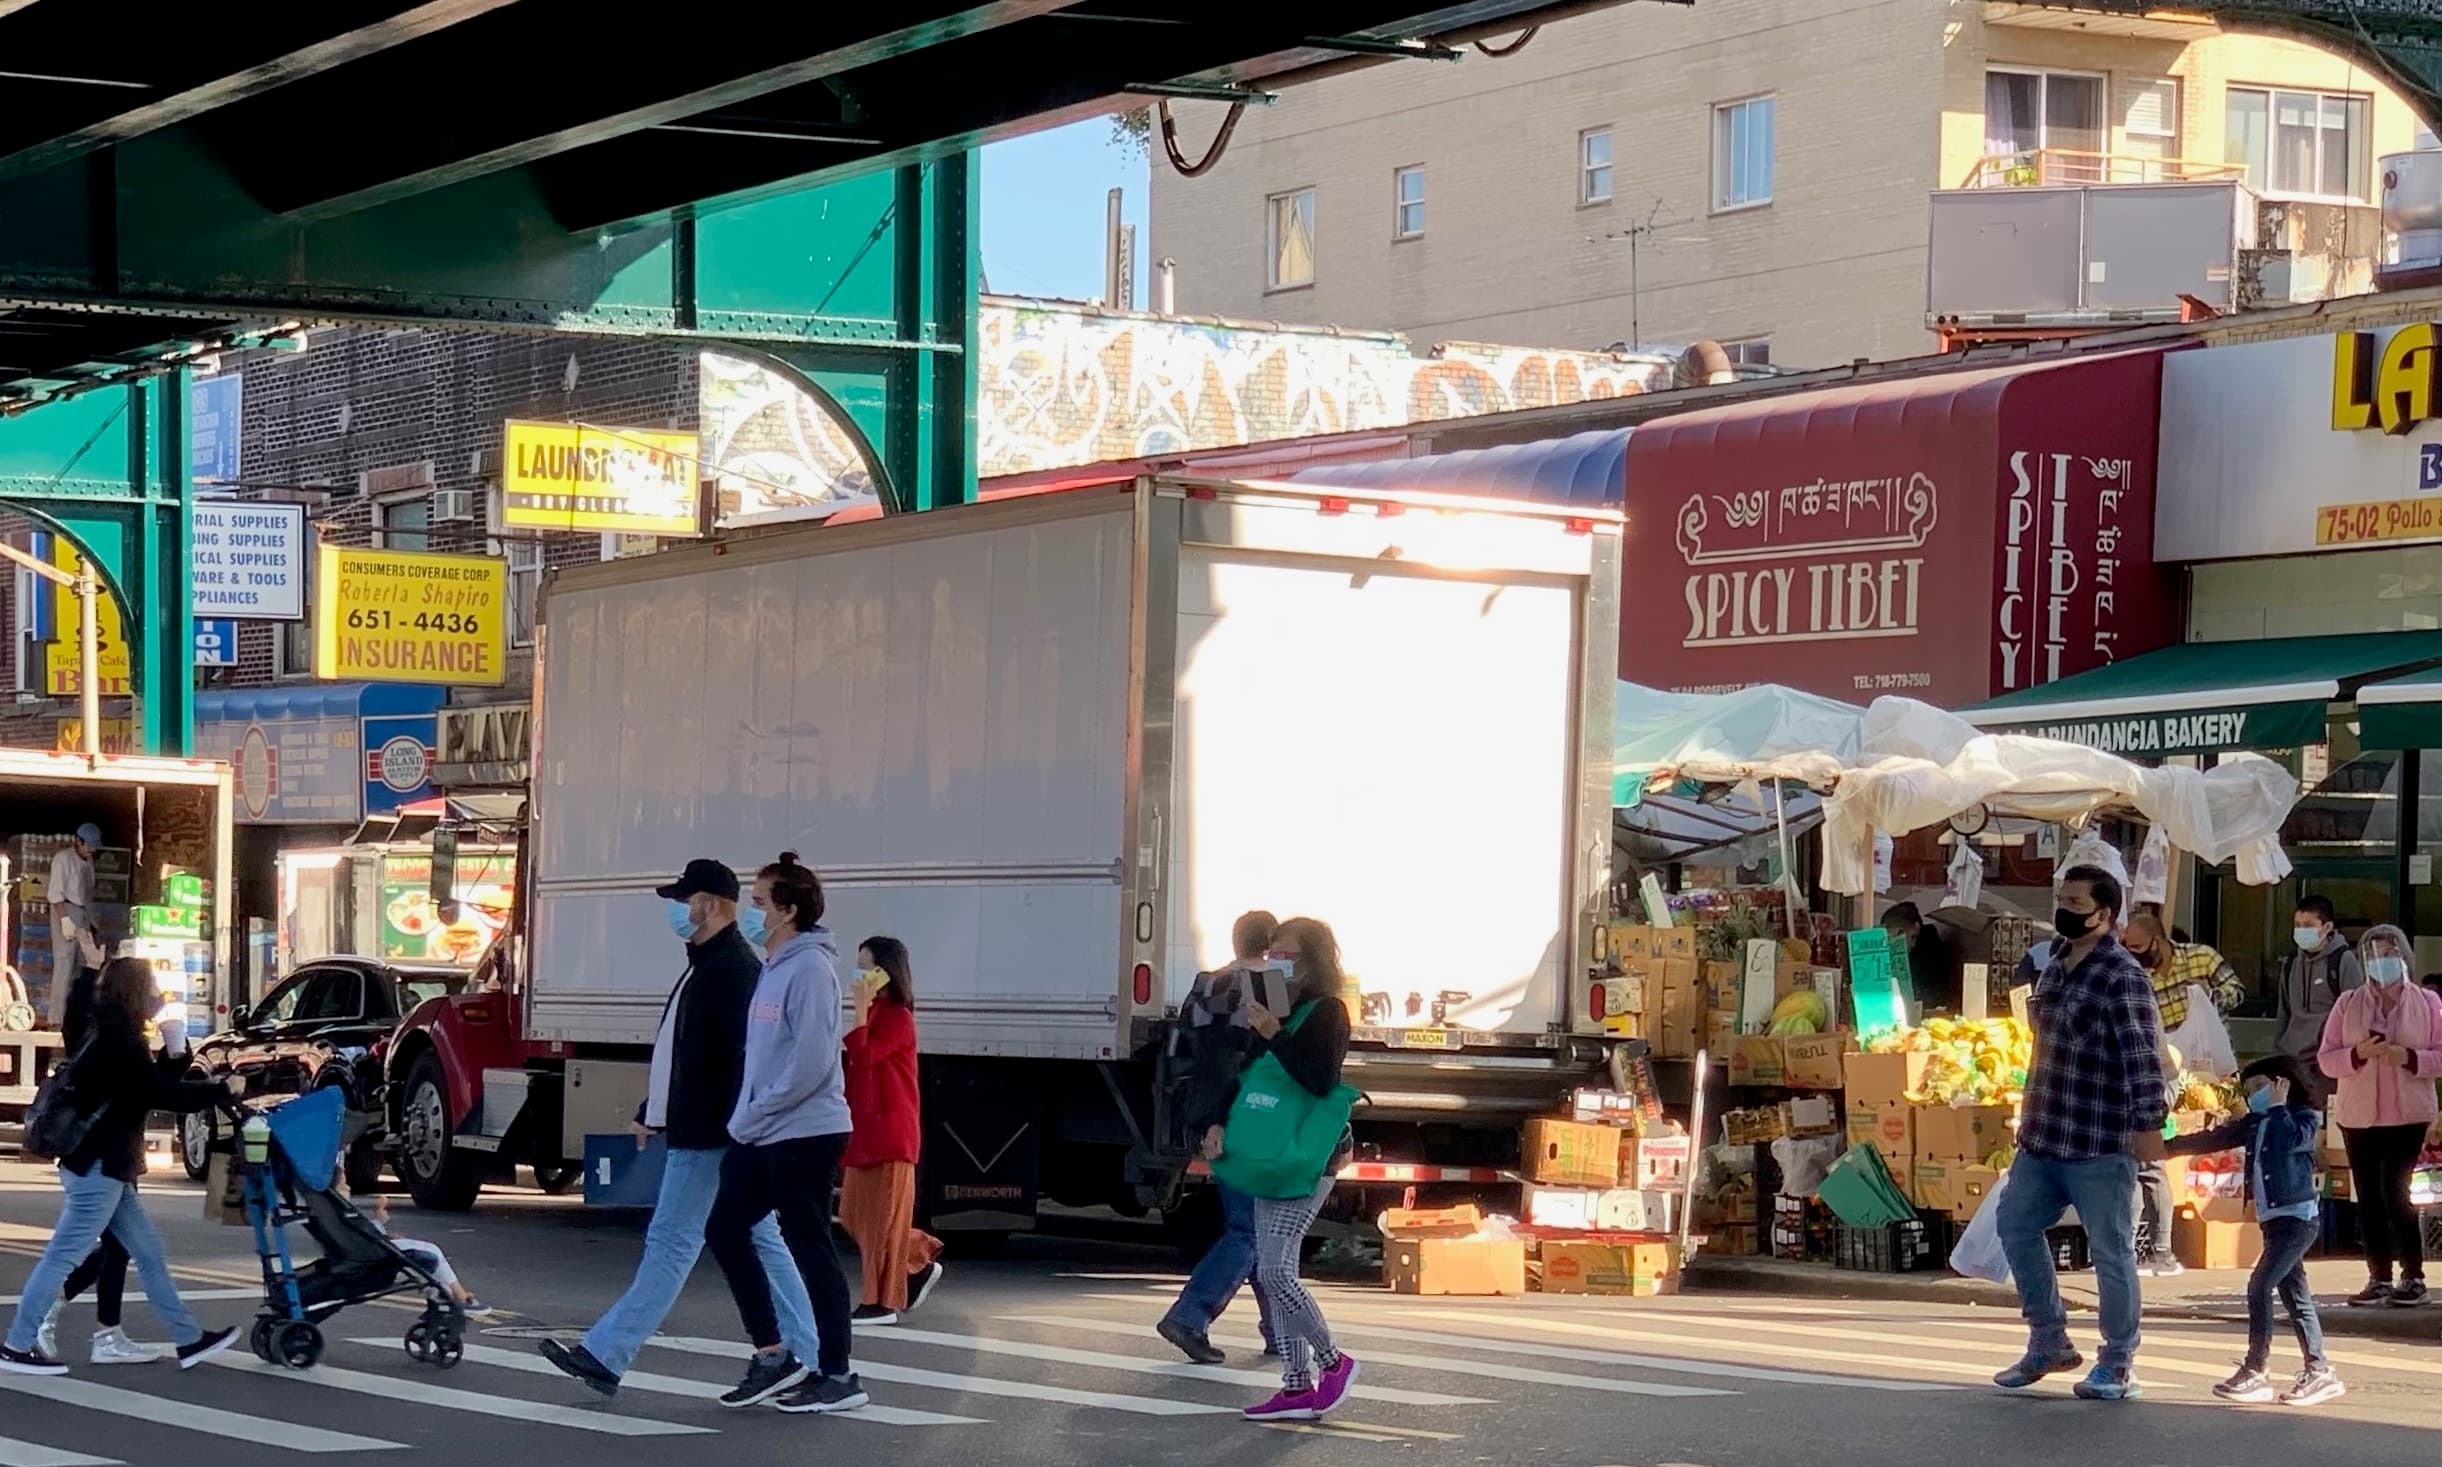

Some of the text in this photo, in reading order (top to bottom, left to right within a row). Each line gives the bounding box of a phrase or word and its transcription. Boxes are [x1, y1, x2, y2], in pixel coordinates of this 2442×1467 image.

[2332, 322, 2436, 435] LA
[517, 443, 690, 486] LAUNDRAT
[192, 513, 288, 529] RIAL SUPPLIES
[2387, 501, 2432, 536] Pollo
[228, 534, 285, 548] SUPPLIES
[192, 552, 287, 567] ICAL SUPPLIES
[1999, 450, 2079, 689] SPICY TIBET
[230, 571, 240, 585] &
[248, 572, 287, 586] TOOLS
[342, 561, 491, 583] CONSUMERS COVERAGE CORP.
[422, 583, 490, 612] Shapiro
[1685, 558, 1924, 640] SPICY TIBET
[339, 636, 489, 673] INSURANCE
[1853, 675, 1873, 689] TEL:
[2164, 712, 2247, 748] BAKERY
[384, 756, 423, 766] ISLAND
[391, 747, 416, 757] LONG
[2041, 825, 2055, 845] A
[1405, 1034, 1444, 1044] MAXON
